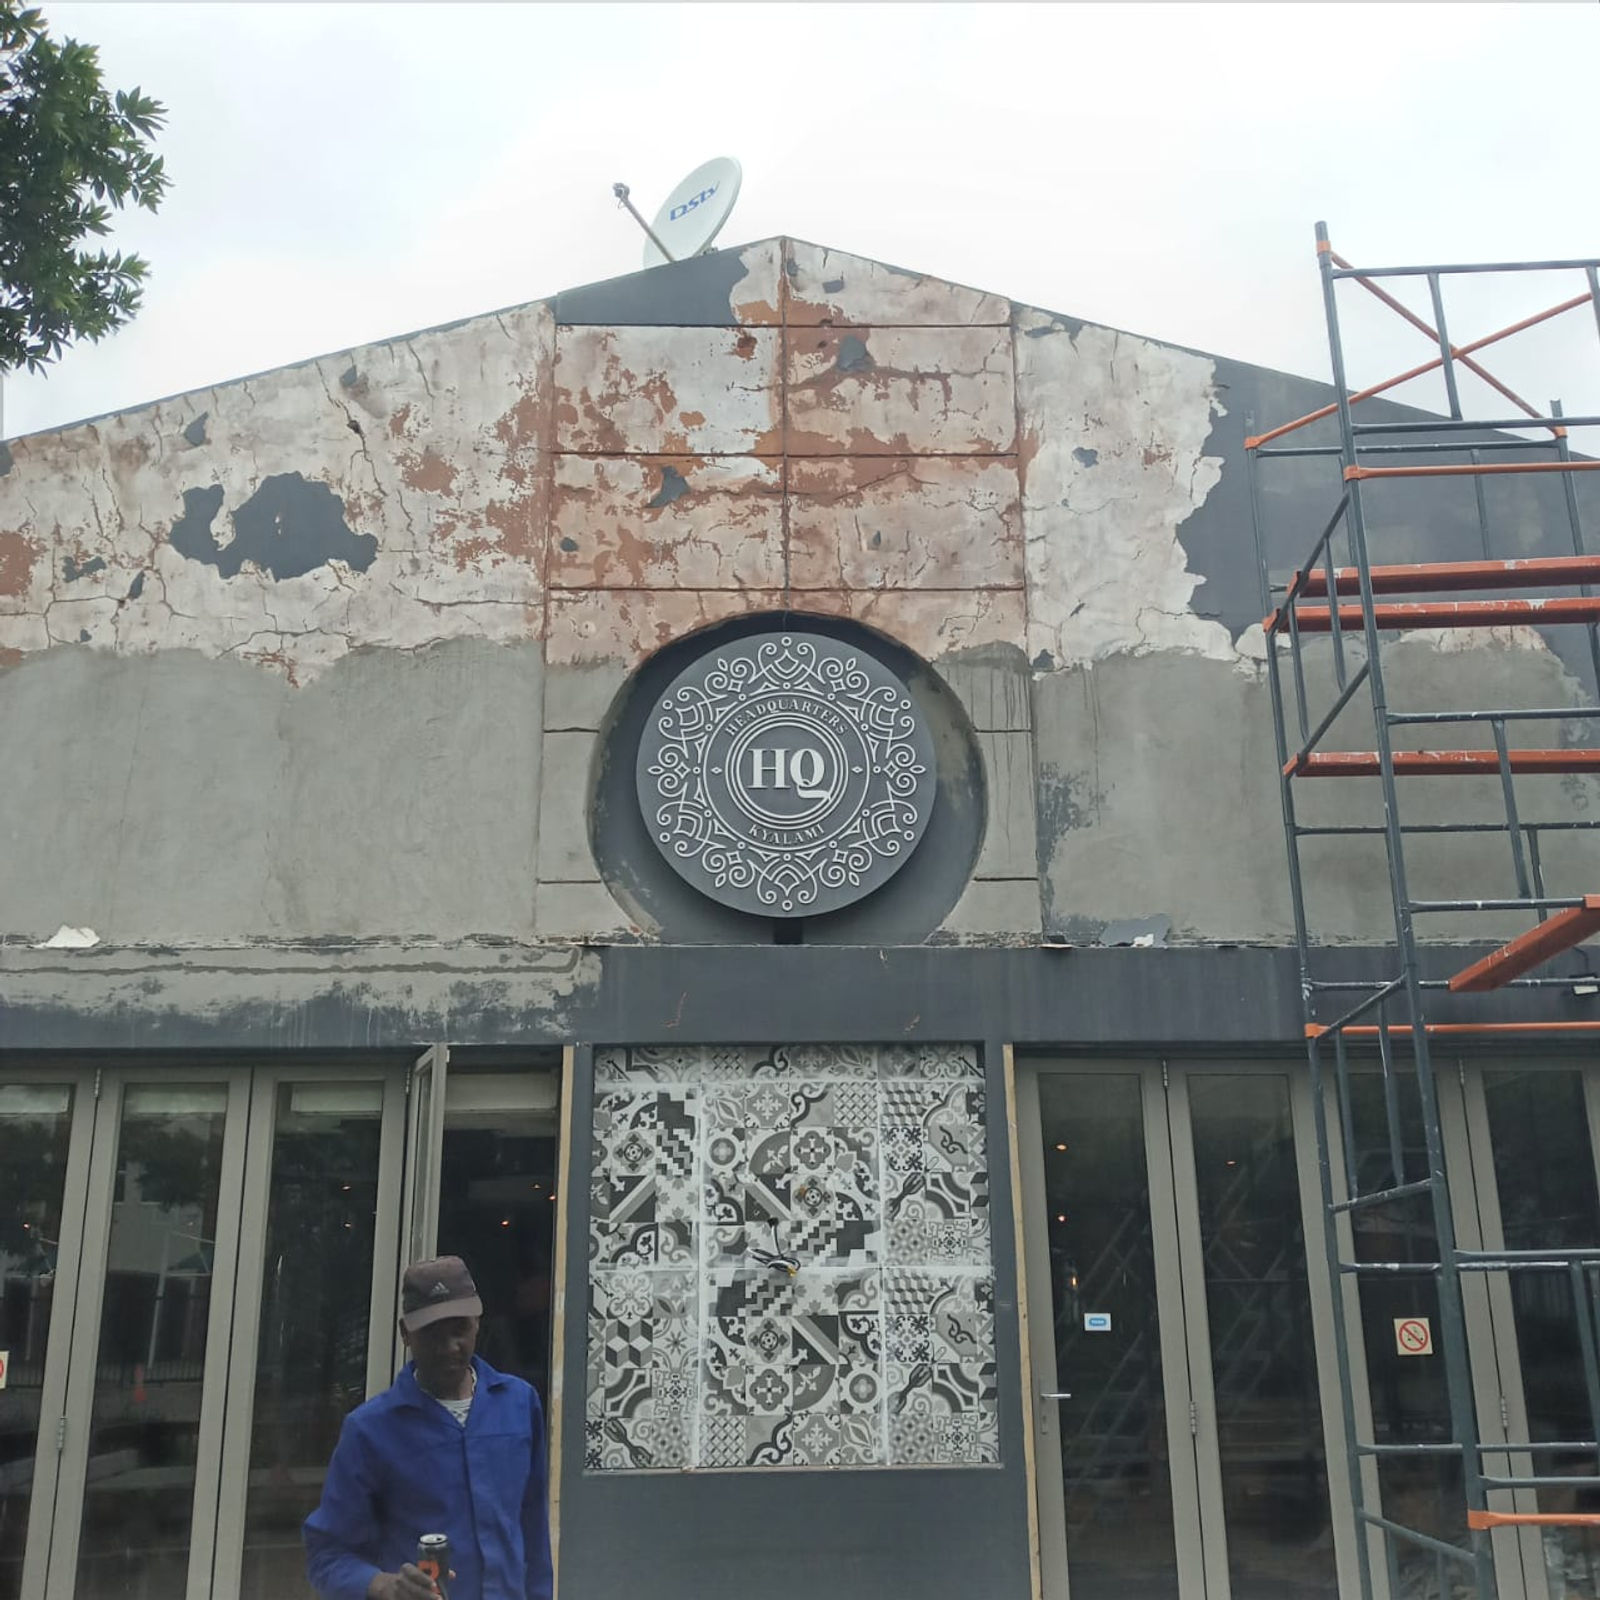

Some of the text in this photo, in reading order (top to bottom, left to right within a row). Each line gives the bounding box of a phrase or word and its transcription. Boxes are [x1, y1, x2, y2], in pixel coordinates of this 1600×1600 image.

[725, 698, 848, 736] HEADQUARTERS
[747, 748, 831, 800] HQ
[749, 823, 825, 844] KYALAMI
